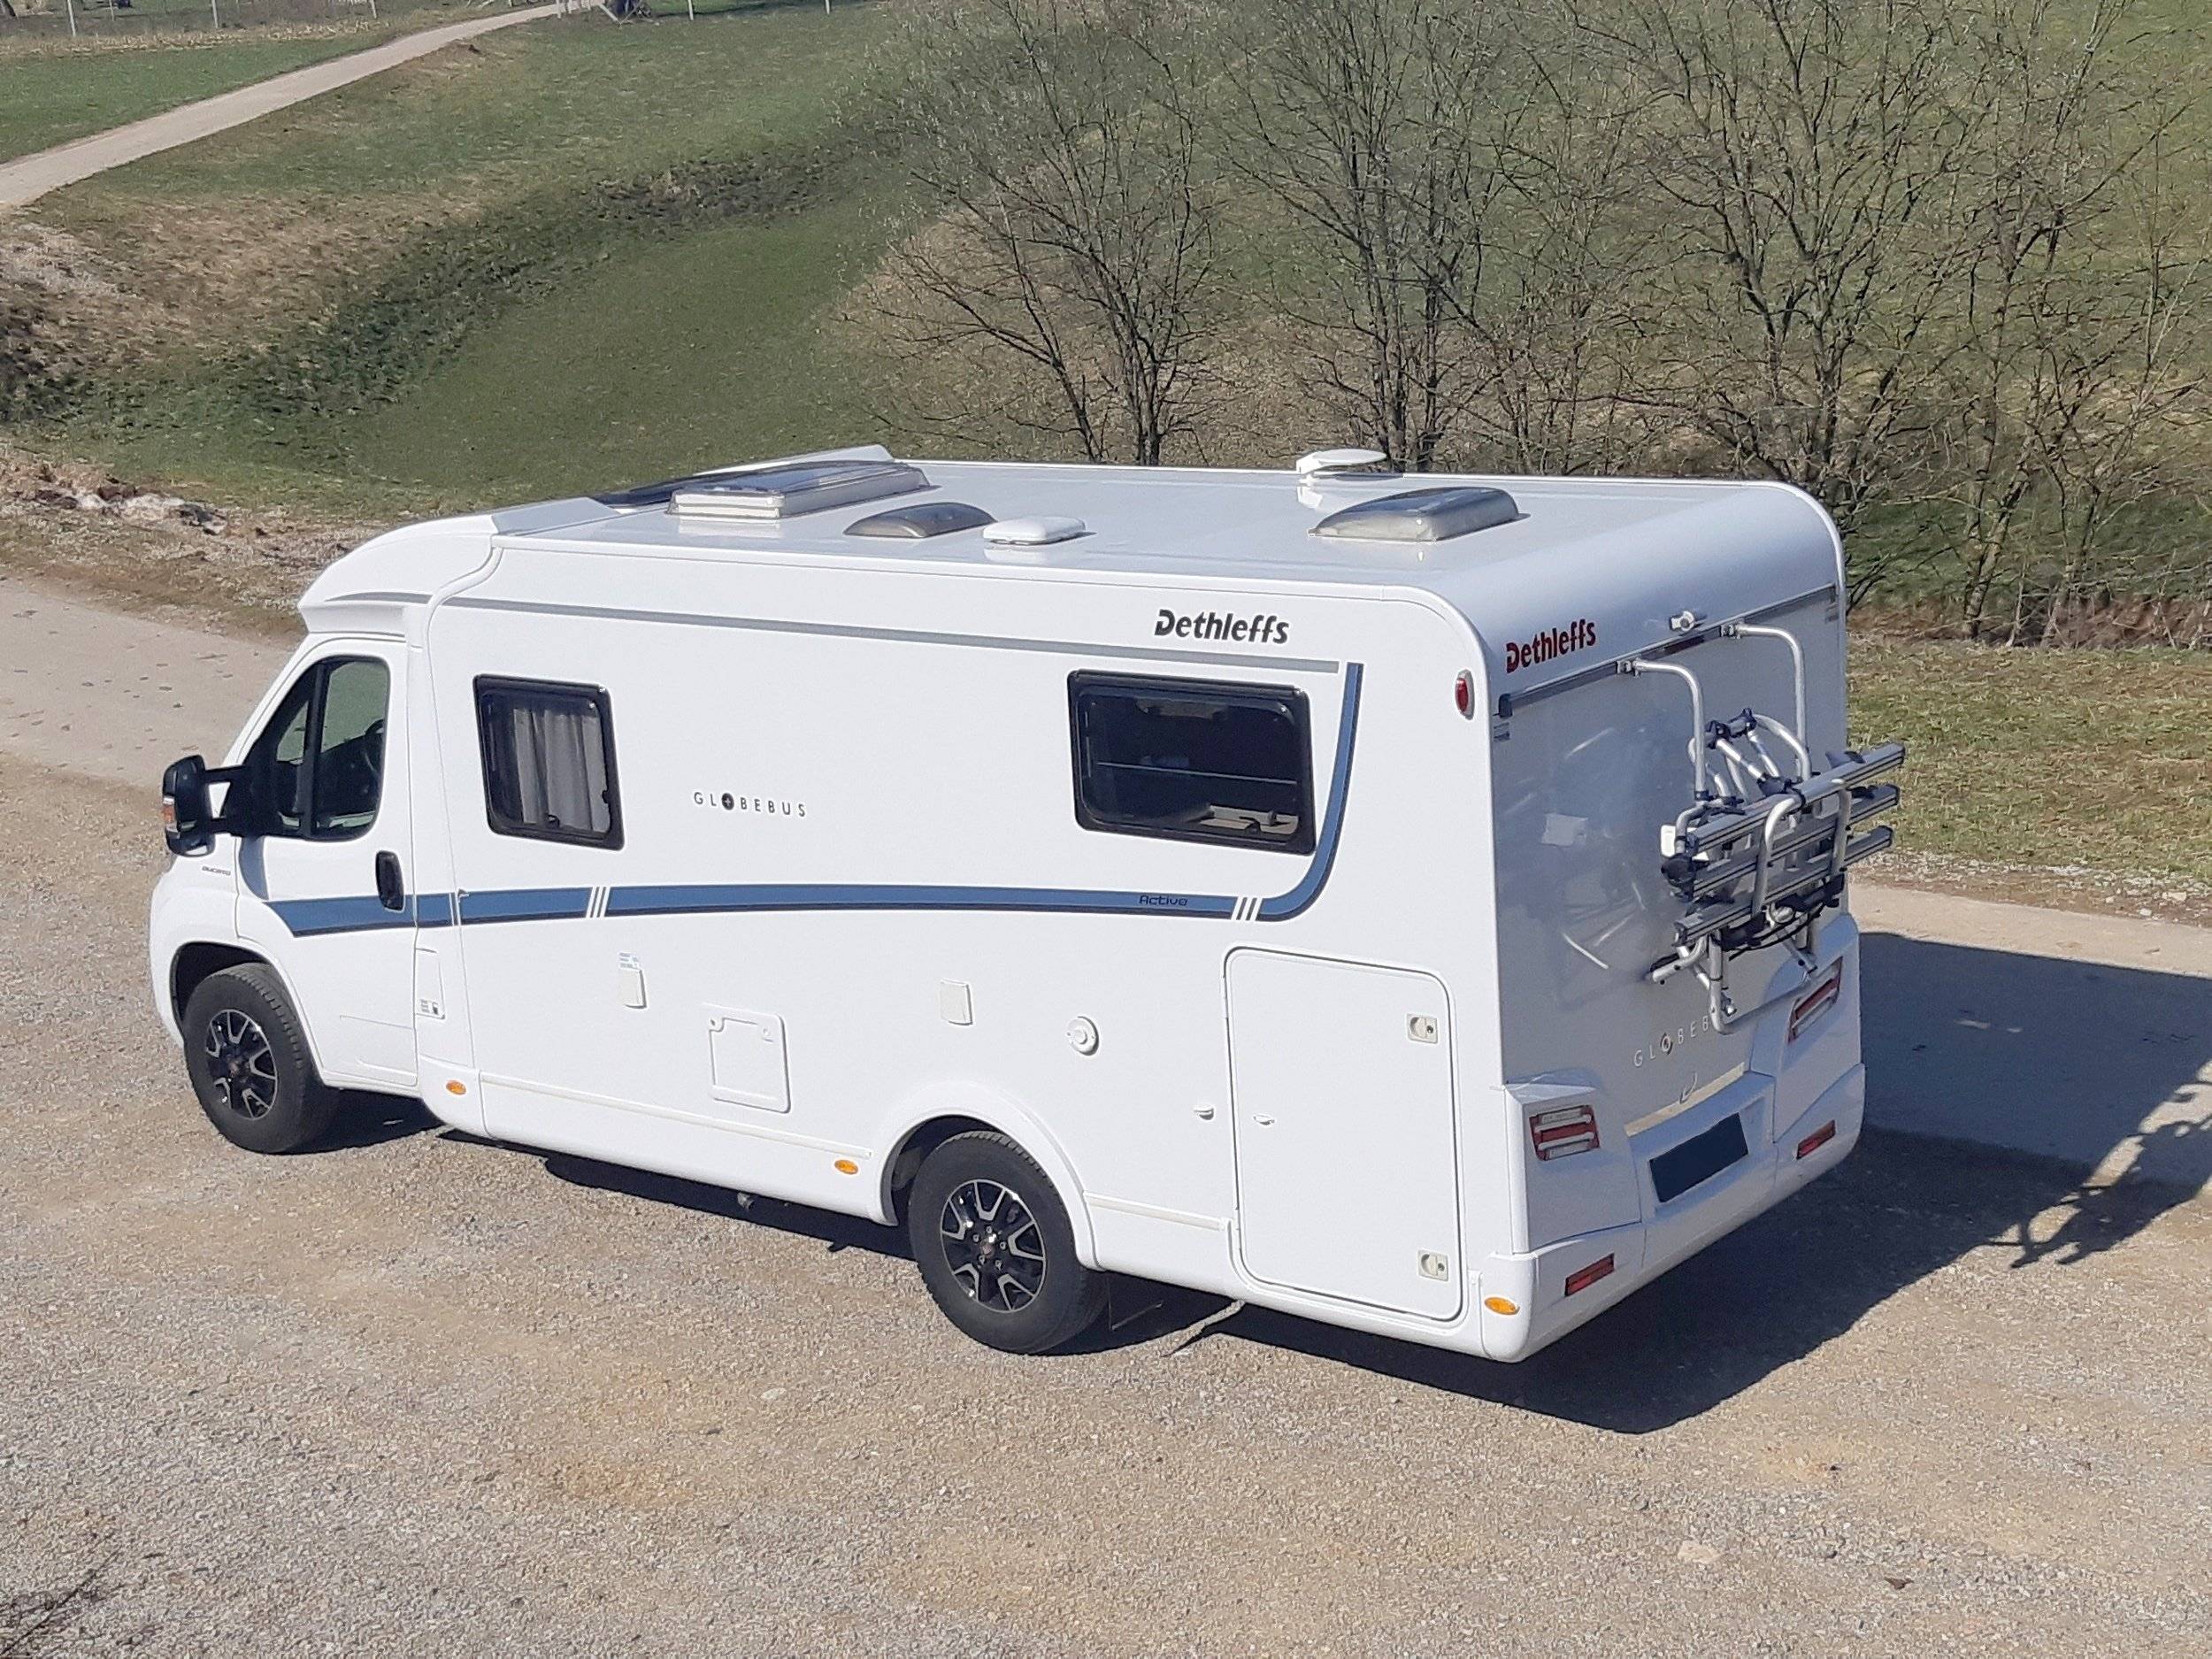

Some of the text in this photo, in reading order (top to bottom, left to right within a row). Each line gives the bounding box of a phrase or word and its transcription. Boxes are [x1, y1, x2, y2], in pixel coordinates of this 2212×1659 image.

[1154, 609, 1289, 644] Dethleffs
[1506, 618, 1596, 673] Dethleffs
[694, 791, 805, 817] GLOBEBUS
[1633, 1015, 1709, 1067] GLOBEB
